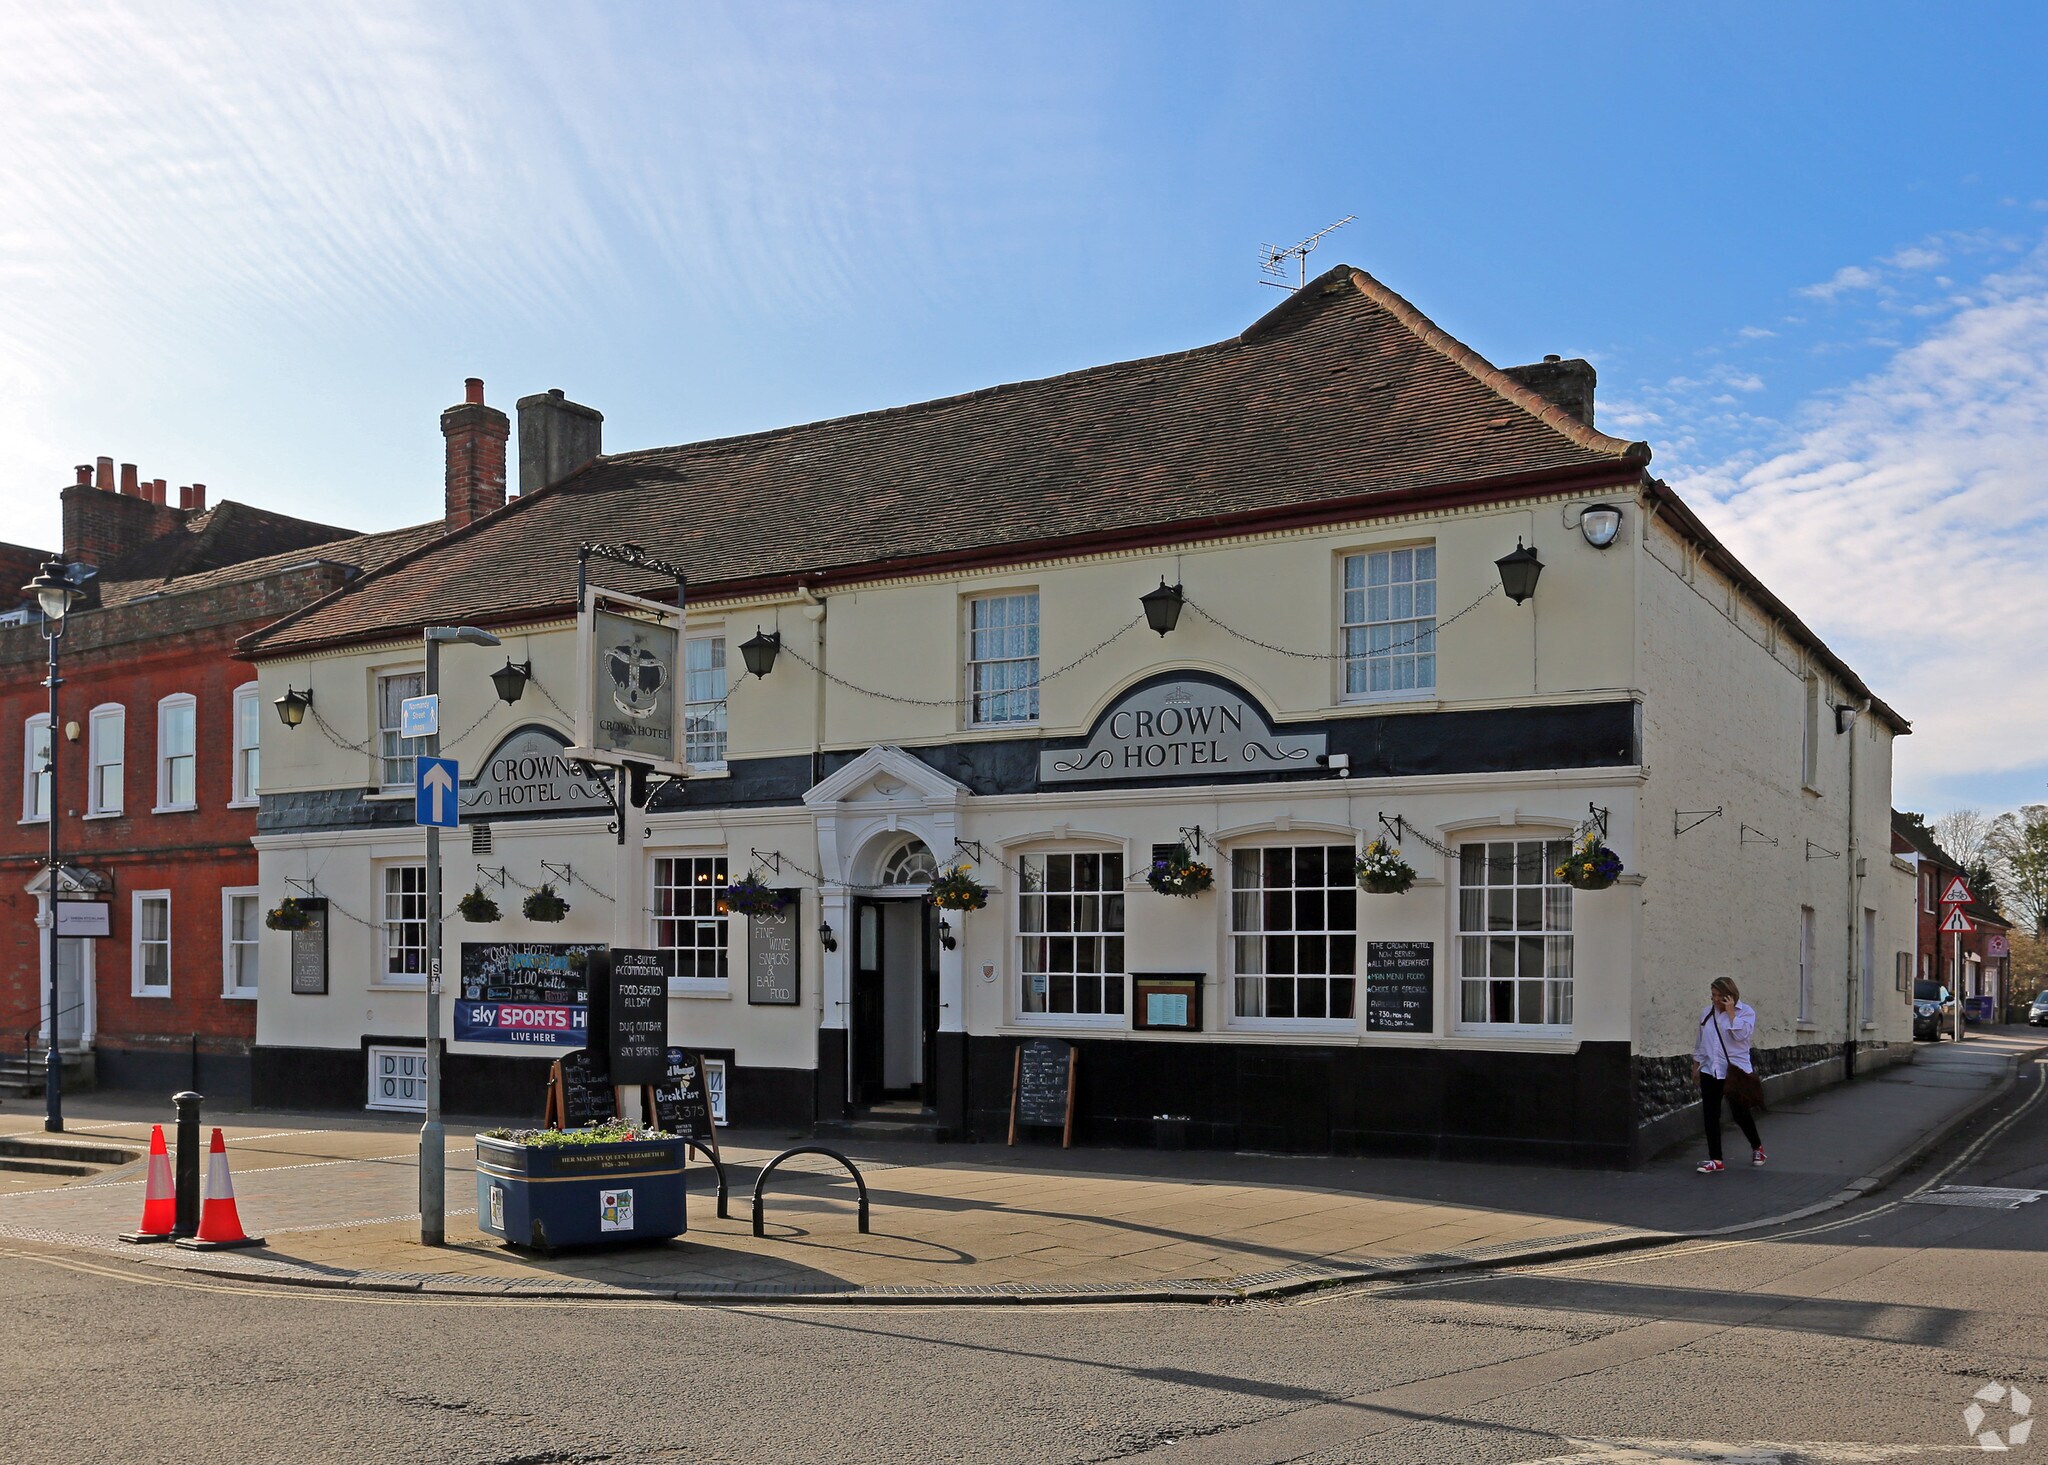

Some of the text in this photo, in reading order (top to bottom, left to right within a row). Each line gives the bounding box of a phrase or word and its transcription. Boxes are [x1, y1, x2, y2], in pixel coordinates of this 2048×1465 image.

[1110, 704, 1243, 740] CROWN
[600, 720, 669, 740] CROWN HOTEL
[1124, 740, 1228, 768] HOTEL
[492, 755, 571, 782] CROWN
[498, 783, 561, 805] HOTEL
[755, 927, 775, 939] FINE
[523, 944, 552, 956] HOTEL
[769, 938, 790, 951] WINE
[759, 953, 790, 966] SNACKS
[1384, 959, 1395, 967] DAY
[1398, 959, 1430, 967] BREAKFAST
[767, 965, 774, 976] &
[756, 975, 775, 987] BAR
[619, 985, 662, 996] FOOD SERVED
[770, 988, 790, 1000] FOOD
[1391, 985, 1398, 993] OF
[625, 998, 651, 1008] ALL DAY
[472, 1006, 588, 1028] sky SPORTS H
[619, 1021, 635, 1034] DUG
[511, 1032, 556, 1042] LIVE HERE
[629, 1034, 645, 1043] WITH
[621, 1047, 634, 1057] SKY
[636, 1046, 660, 1057] SPORTS
[384, 1078, 427, 1098] OU
[627, 1152, 659, 1160] ELIZABETH
